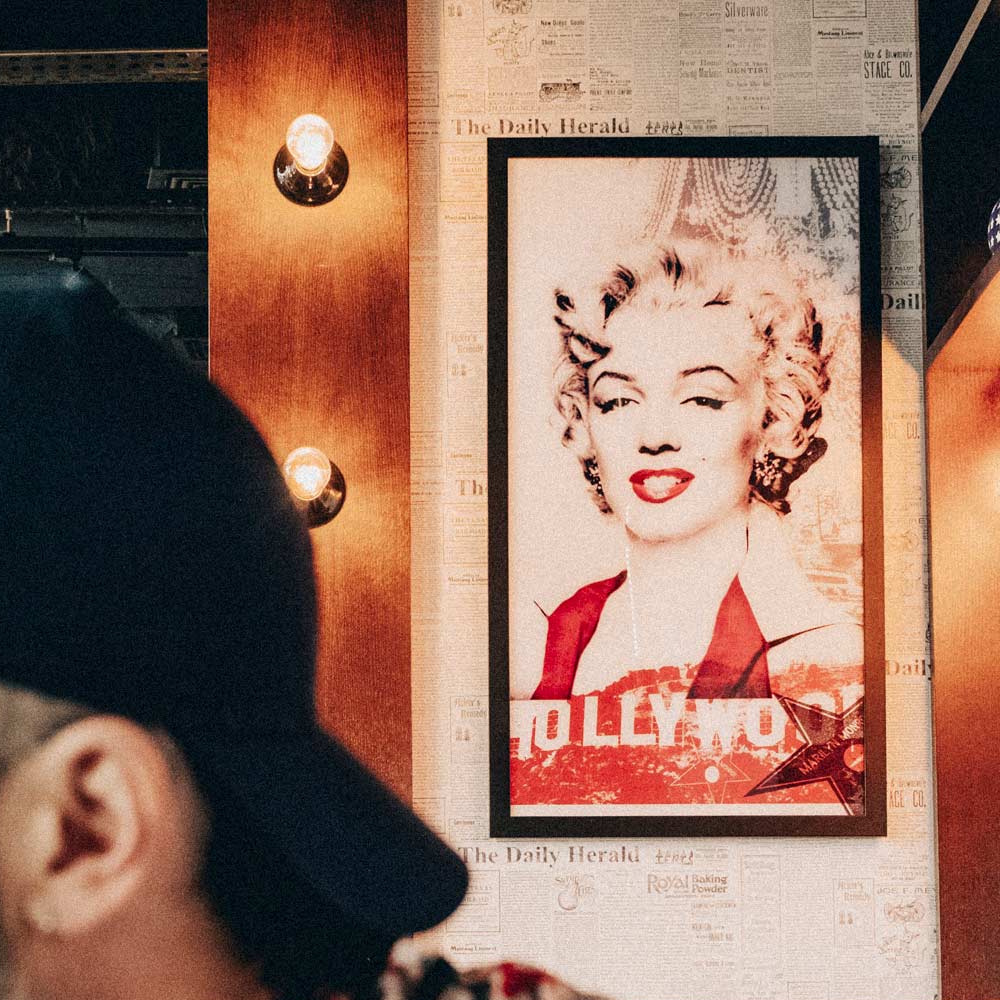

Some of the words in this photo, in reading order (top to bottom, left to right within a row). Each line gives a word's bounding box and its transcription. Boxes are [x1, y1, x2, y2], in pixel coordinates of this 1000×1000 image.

[725, 2, 768, 18] Silverware
[864, 61, 891, 79] STAGE
[899, 61, 912, 78] CO.
[451, 119, 491, 135] The
[500, 118, 550, 138] Daily
[560, 117, 631, 135] Herald
[456, 479, 488, 495] Th
[457, 846, 498, 864] The
[506, 845, 560, 868] Daily
[569, 846, 641, 863] Herald
[647, 873, 689, 894] Royal
[692, 874, 729, 885] Baking
[692, 884, 729, 894] Powder
